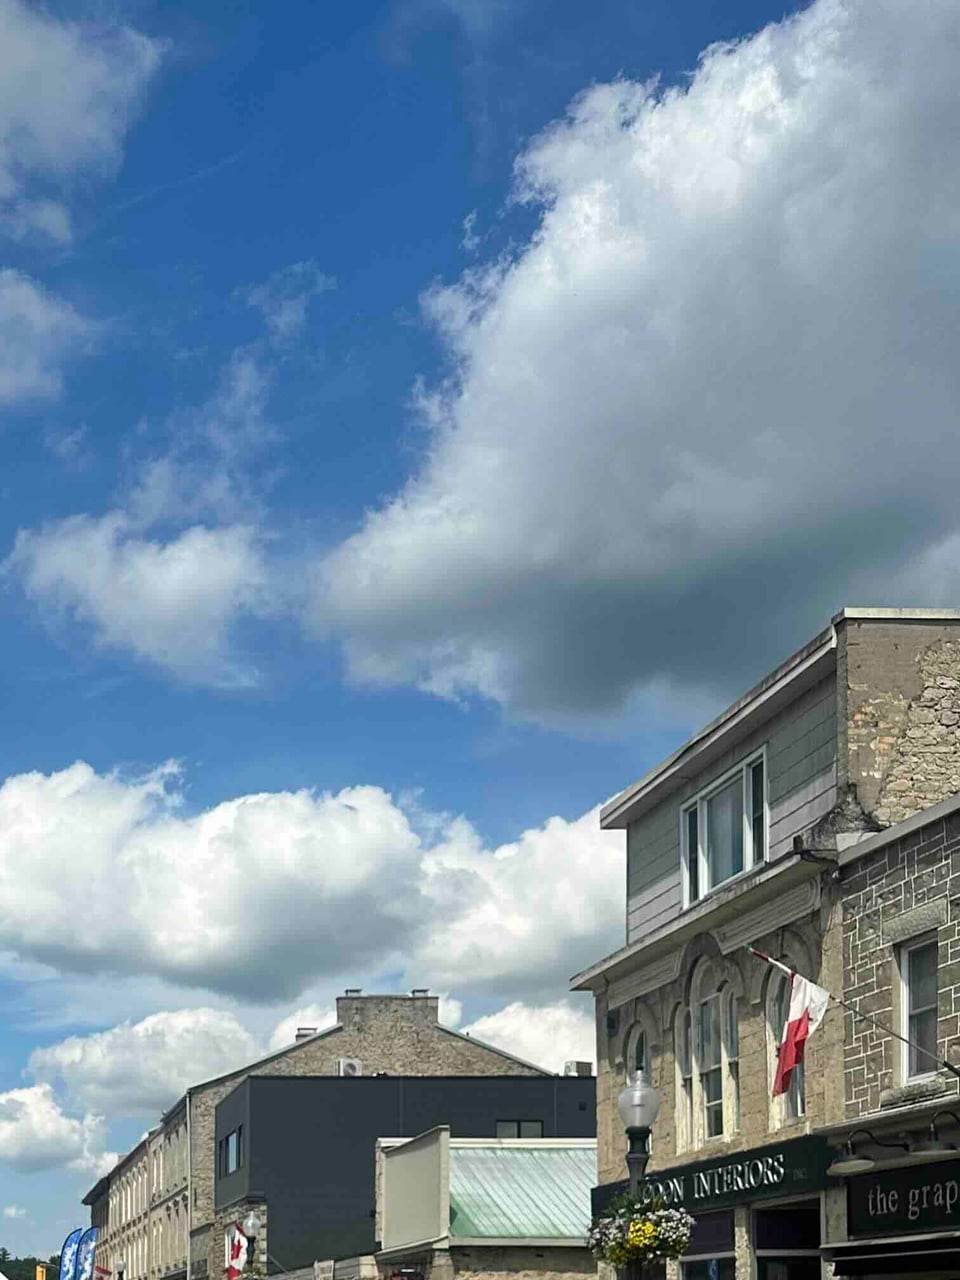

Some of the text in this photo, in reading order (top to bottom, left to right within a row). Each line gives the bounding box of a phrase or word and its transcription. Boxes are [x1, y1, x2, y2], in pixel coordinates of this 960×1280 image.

[693, 1154, 784, 1198] INTERIORS
[868, 1180, 959, 1220] the grap
